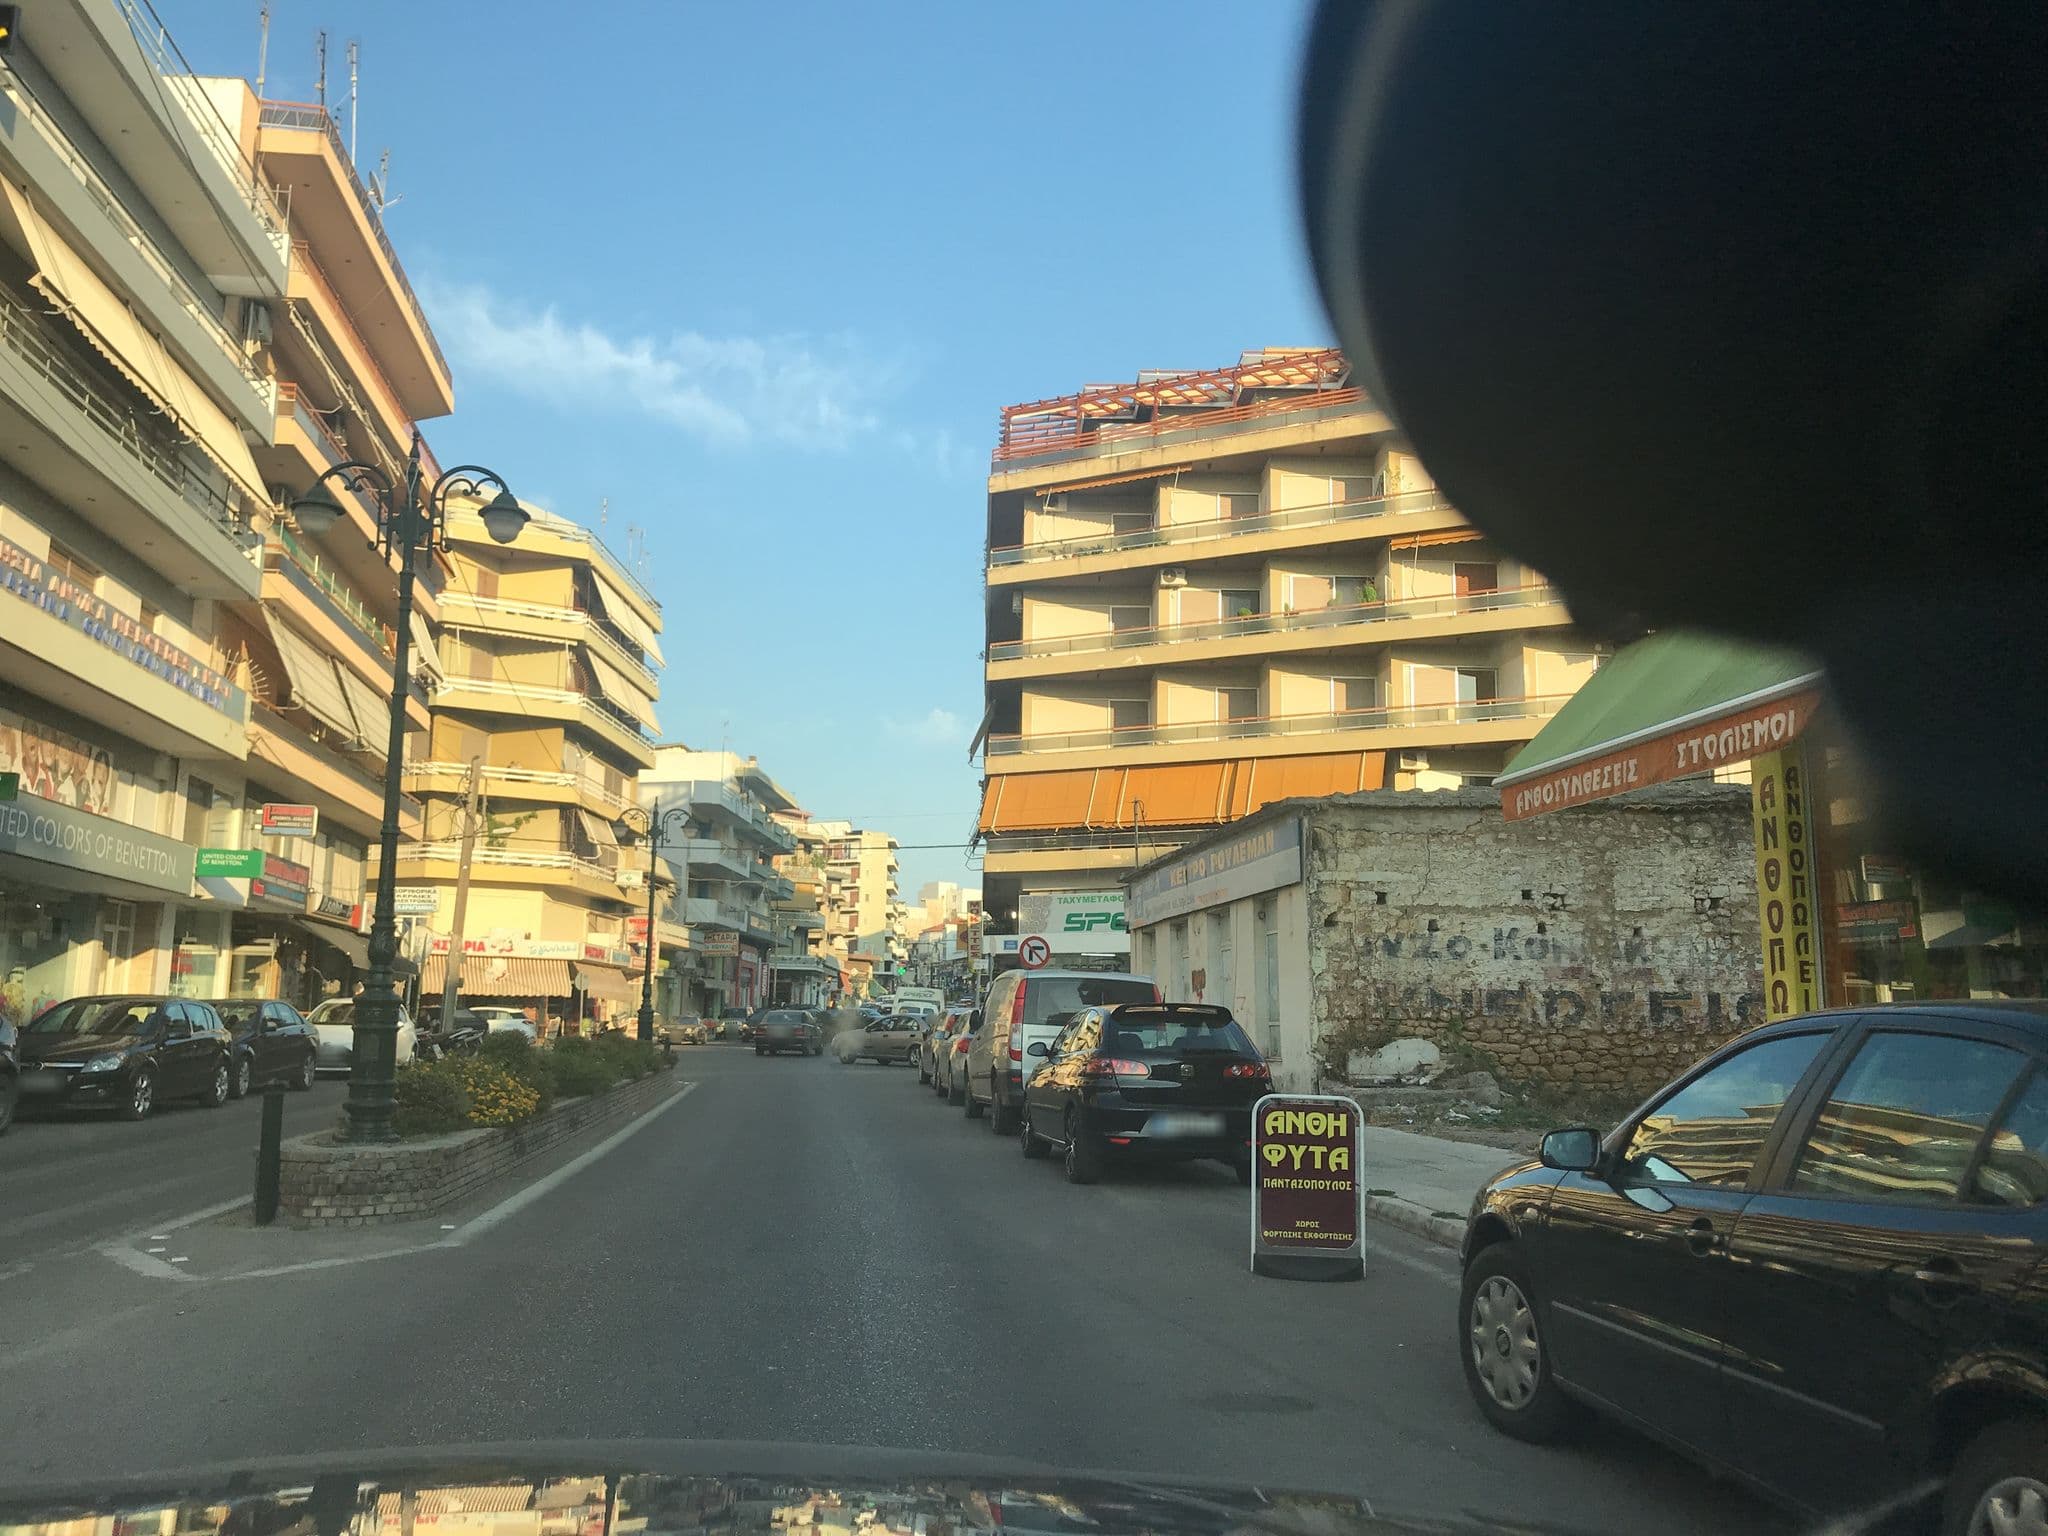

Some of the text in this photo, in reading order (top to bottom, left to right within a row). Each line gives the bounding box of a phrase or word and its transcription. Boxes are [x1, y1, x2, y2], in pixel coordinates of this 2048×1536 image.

[1676, 709, 1796, 769] ΣΤΟΛΙΣΜΟΙ
[33, 815, 92, 856] COLORS
[95, 834, 113, 859] OF
[1210, 829, 1275, 873] ΡΟΥΛΕΜΑΝ
[1056, 895, 1125, 905] ΤΑΧΥΜΕΤΑΦΟ
[1264, 1110, 1348, 1139] ΑΝΘΗ
[1262, 1143, 1350, 1173] ΦΥΤΑ
[1263, 1177, 1352, 1191] ΠΑΝΤΑΖΟΠΟΥΛΟΣ
[1263, 1230, 1353, 1241] ΦΟΡΤΩΣΗΣ ΕΚΦΟΡΤΩΣΗΣ
[1295, 1220, 1320, 1229] ΧΩΡΟΣ
